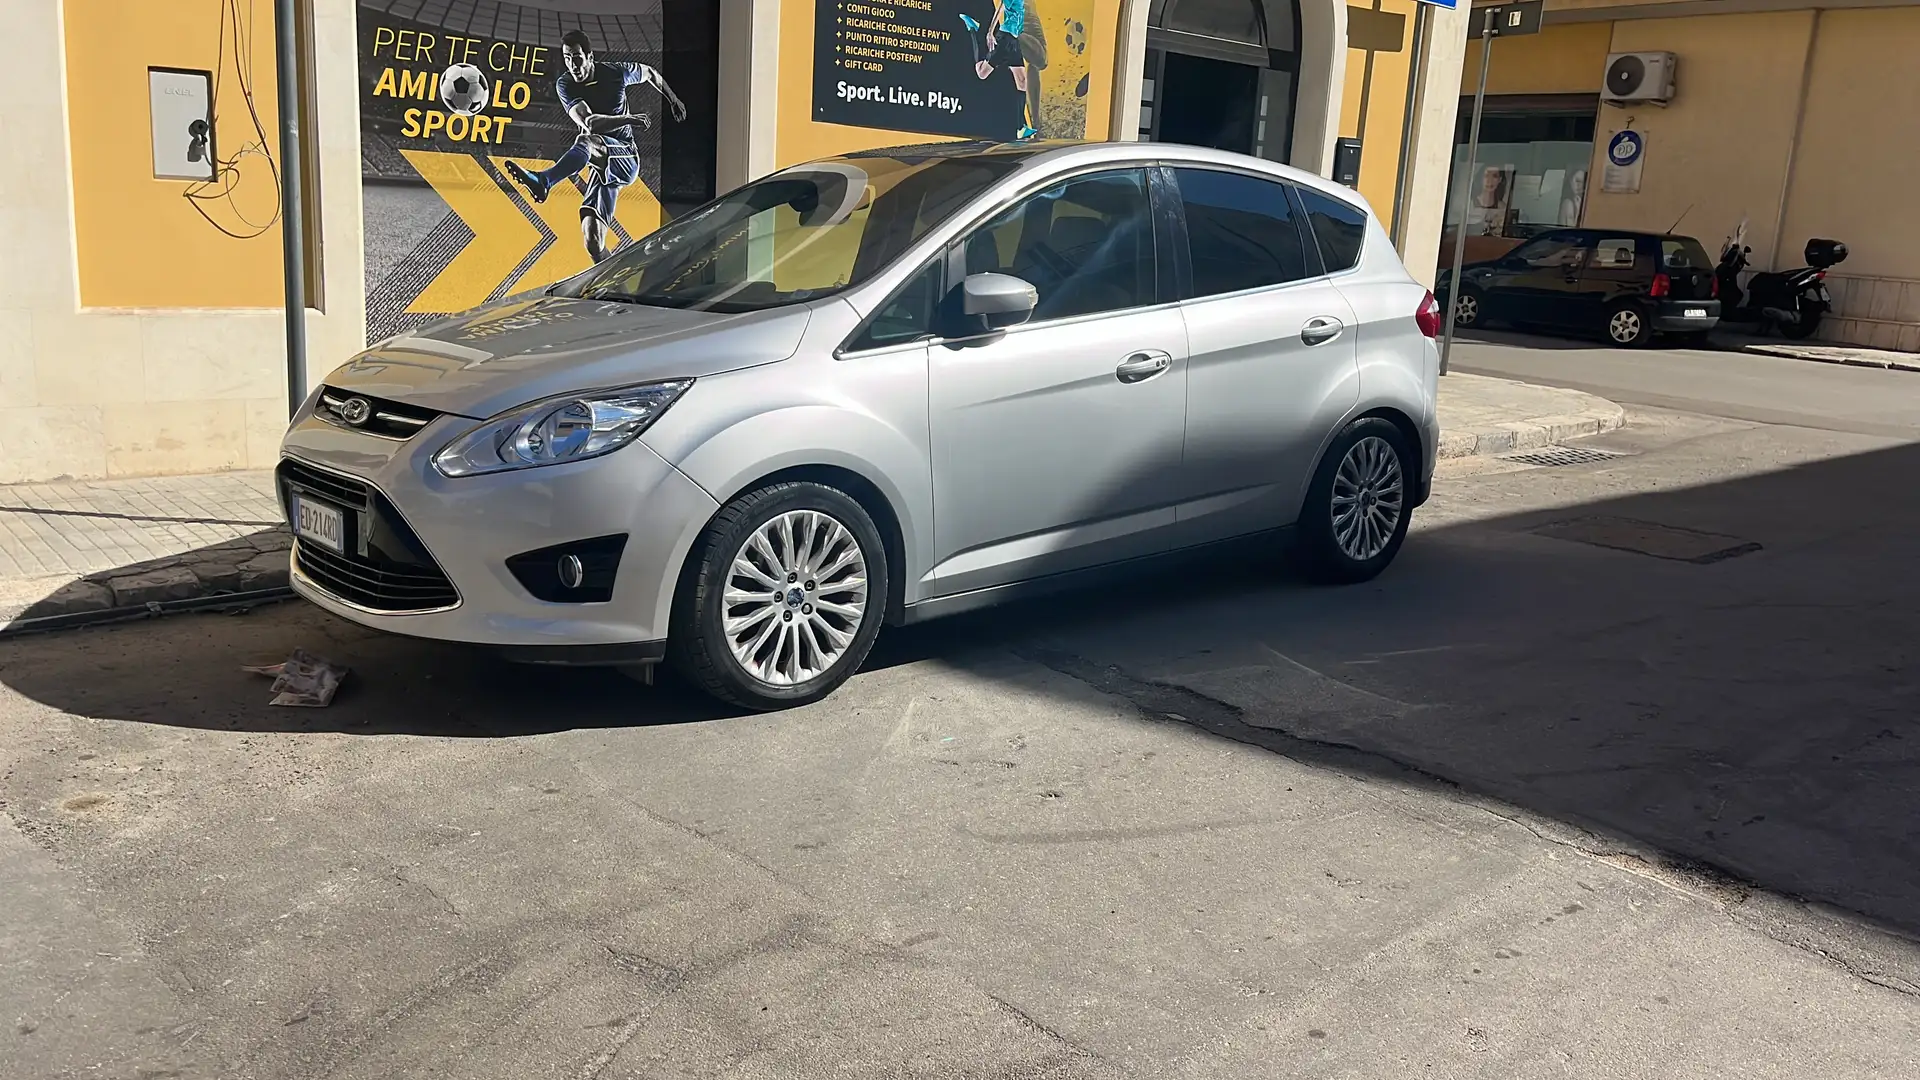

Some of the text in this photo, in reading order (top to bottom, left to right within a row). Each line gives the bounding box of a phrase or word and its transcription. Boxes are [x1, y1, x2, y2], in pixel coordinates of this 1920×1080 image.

[846, 3, 895, 19] CONTI GIOCO
[846, 17, 951, 41] RICARICHE CONSOLE E PAY TV
[373, 27, 549, 76] PER TE CHE
[845, 31, 940, 53] PUNTO RITIRO SPEDIZIONI
[844, 59, 883, 72] GIFT CARD
[845, 45, 922, 64] RICARICHE POSTEPAY
[373, 67, 531, 110] AMI LO
[837, 80, 962, 114] Sport. Live. Play.
[400, 107, 513, 145] SPORT
